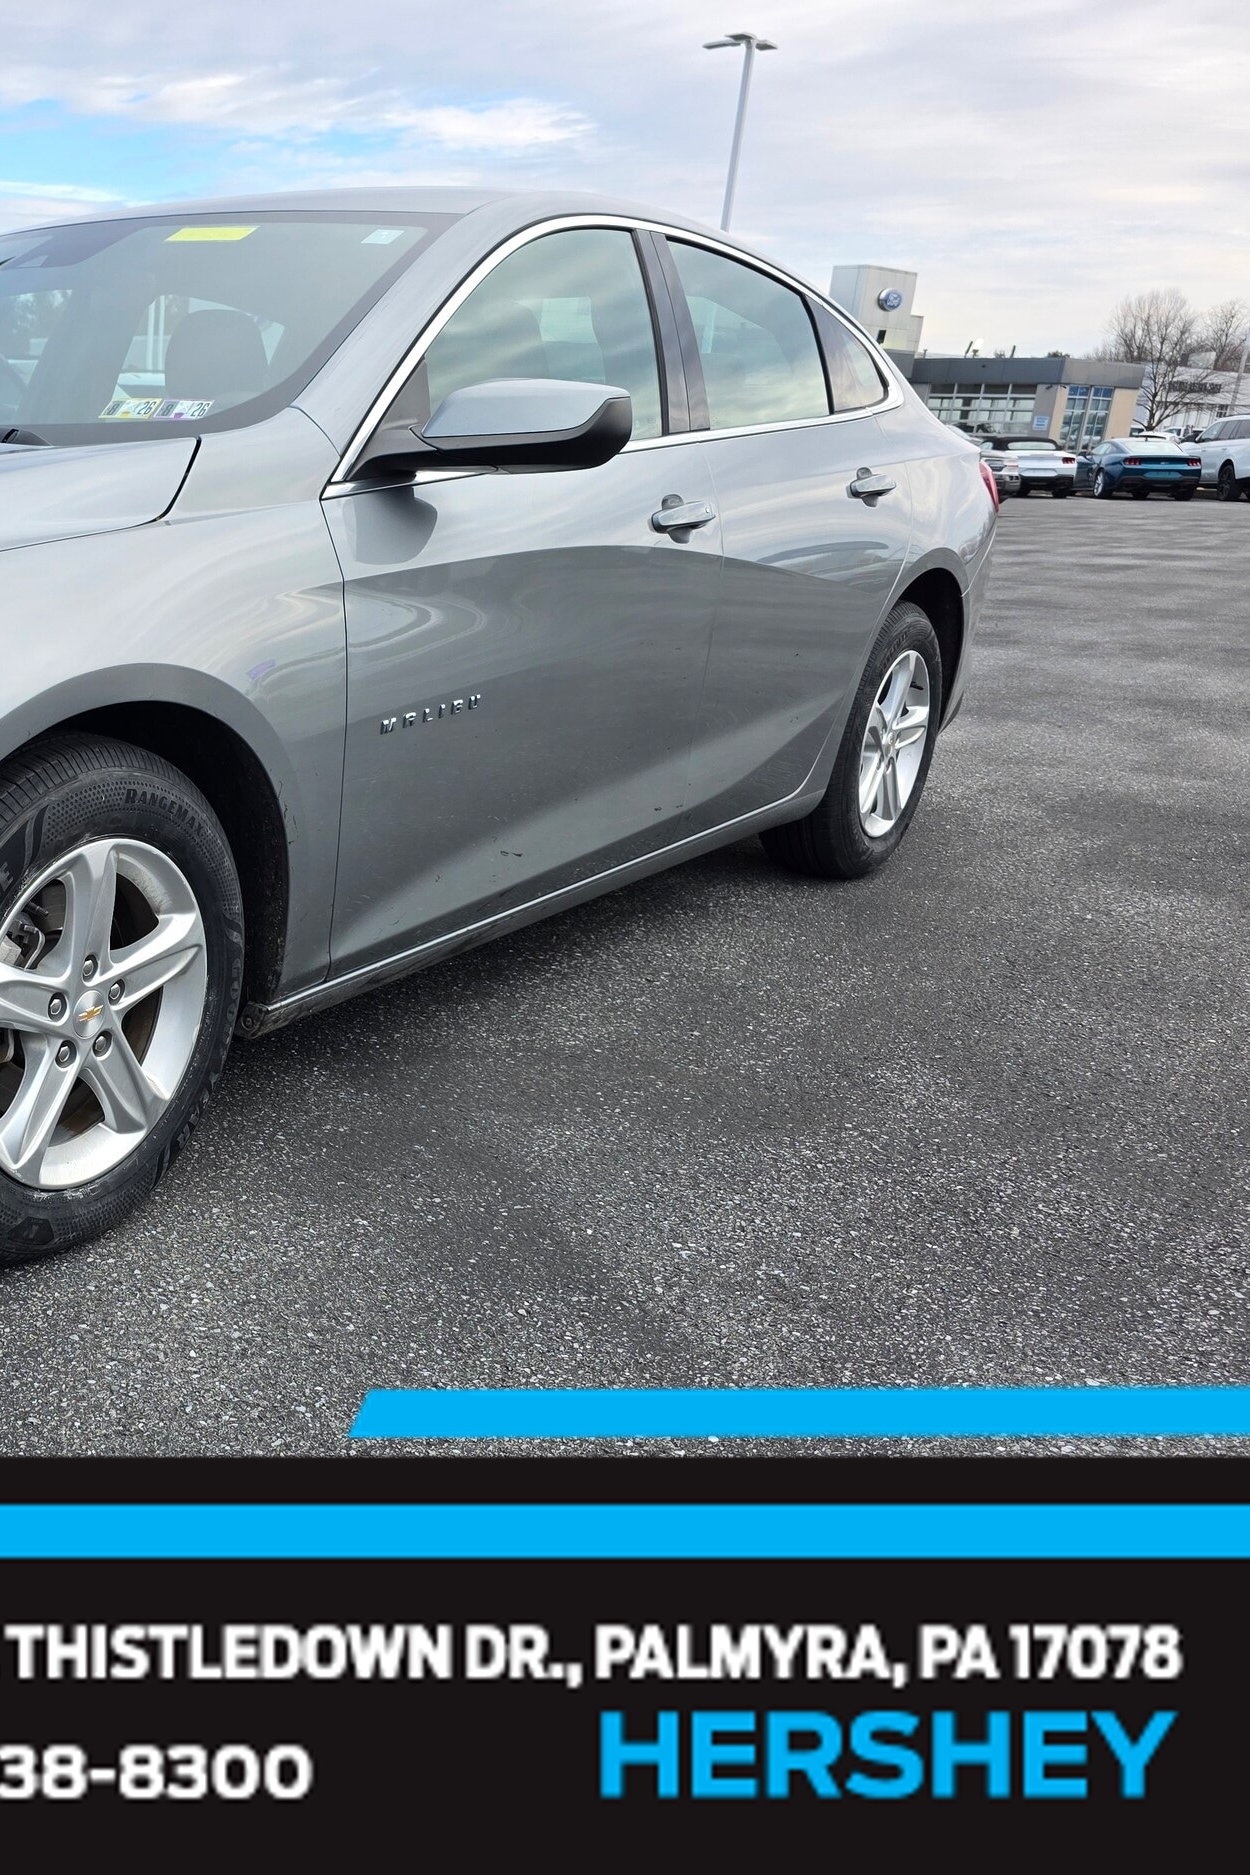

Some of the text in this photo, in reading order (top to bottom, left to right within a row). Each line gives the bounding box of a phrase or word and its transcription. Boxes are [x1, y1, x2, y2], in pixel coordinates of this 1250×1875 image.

[137, 401, 157, 415] 26
[190, 402, 210, 417] 26
[124, 788, 204, 837] RANGEMAX
